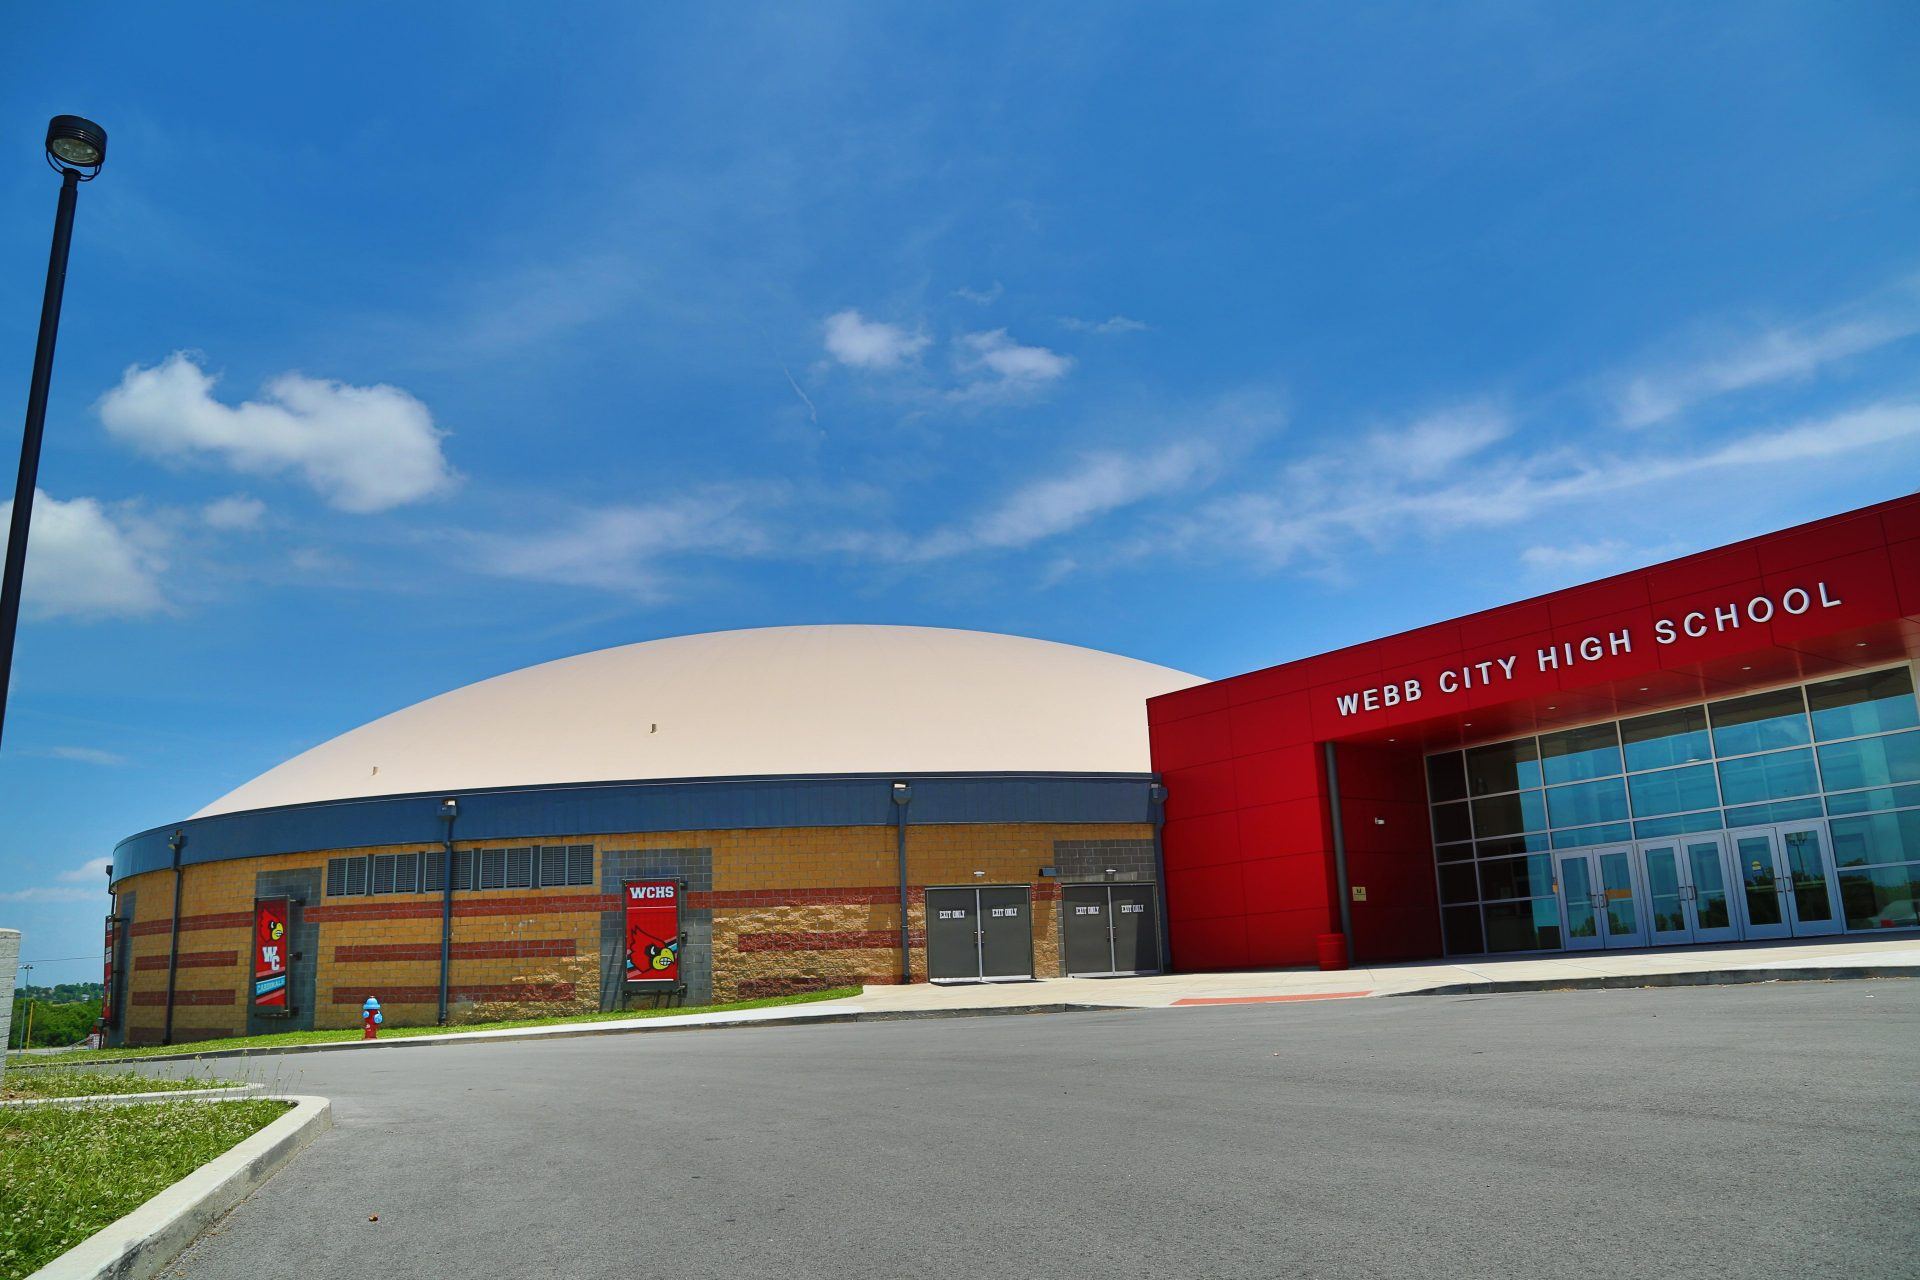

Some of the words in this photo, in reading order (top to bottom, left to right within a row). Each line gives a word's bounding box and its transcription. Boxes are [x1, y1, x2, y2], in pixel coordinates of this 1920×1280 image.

[1336, 679, 1422, 716] WEBB
[1439, 655, 1517, 693] CITY
[1537, 629, 1632, 672] HIGH
[1655, 582, 1842, 644] SCHOOL
[629, 886, 674, 899] WCHS
[992, 908, 1004, 917] EXIT
[1005, 908, 1018, 917] ONLY
[1076, 906, 1087, 915] EXIT
[1088, 906, 1100, 915] ONLY
[1121, 905, 1132, 913] EXIT
[1132, 904, 1144, 913] ONLY
[940, 910, 951, 919] EXIT
[952, 910, 965, 919] ONLY
